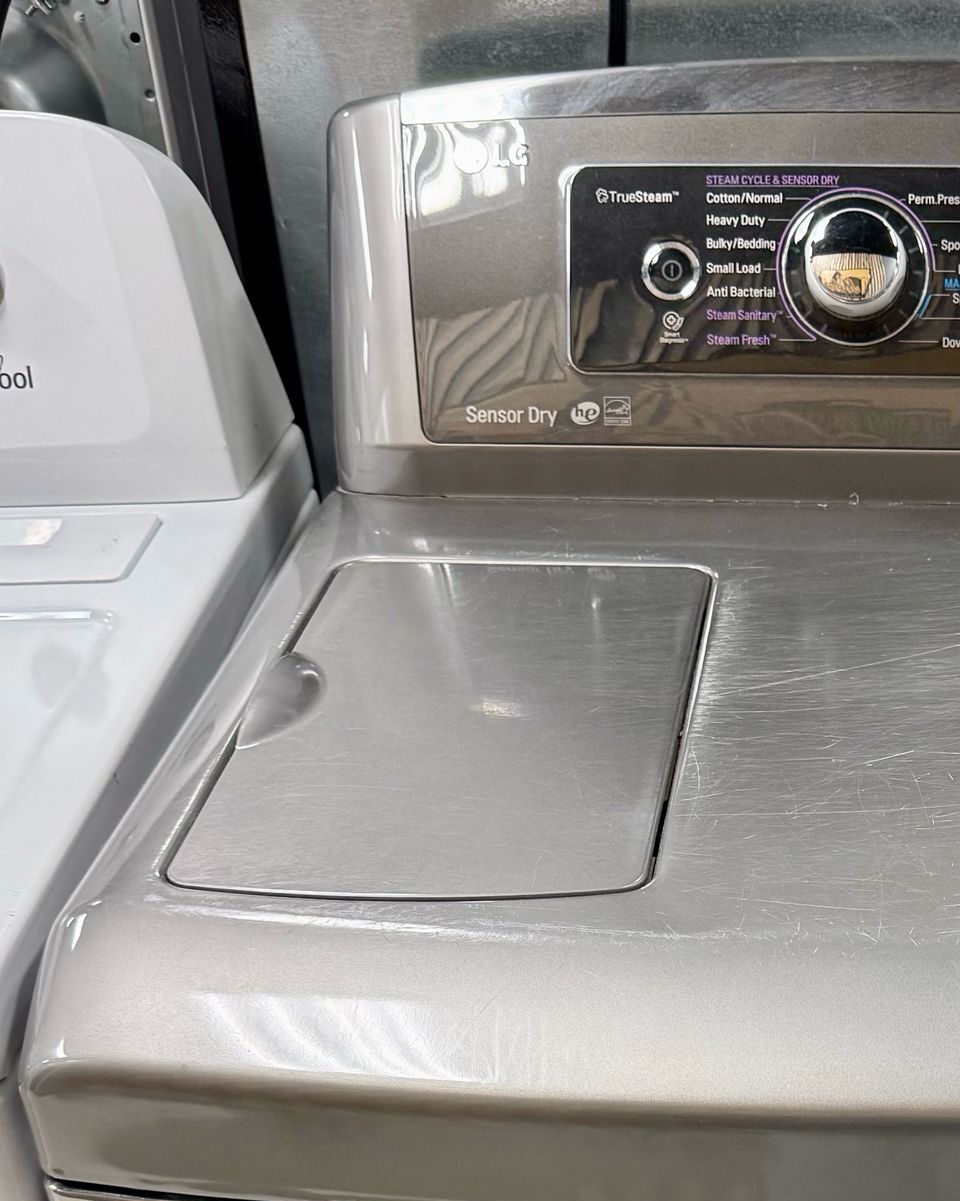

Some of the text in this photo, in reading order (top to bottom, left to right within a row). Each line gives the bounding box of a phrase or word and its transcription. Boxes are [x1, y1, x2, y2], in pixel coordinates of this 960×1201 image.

[706, 176, 839, 185] STEAM CYCLE & SENSOR DRY
[706, 193, 782, 204] Cotton/Normal
[706, 215, 765, 227] Heavy Duty
[706, 238, 776, 251] Bulky/Bedding
[706, 263, 760, 274] Small Load
[707, 286, 775, 298] Anti Bacterial
[707, 310, 736, 320] Steam
[707, 334, 739, 345] Steam
[466, 405, 557, 427] Sensor Dry
